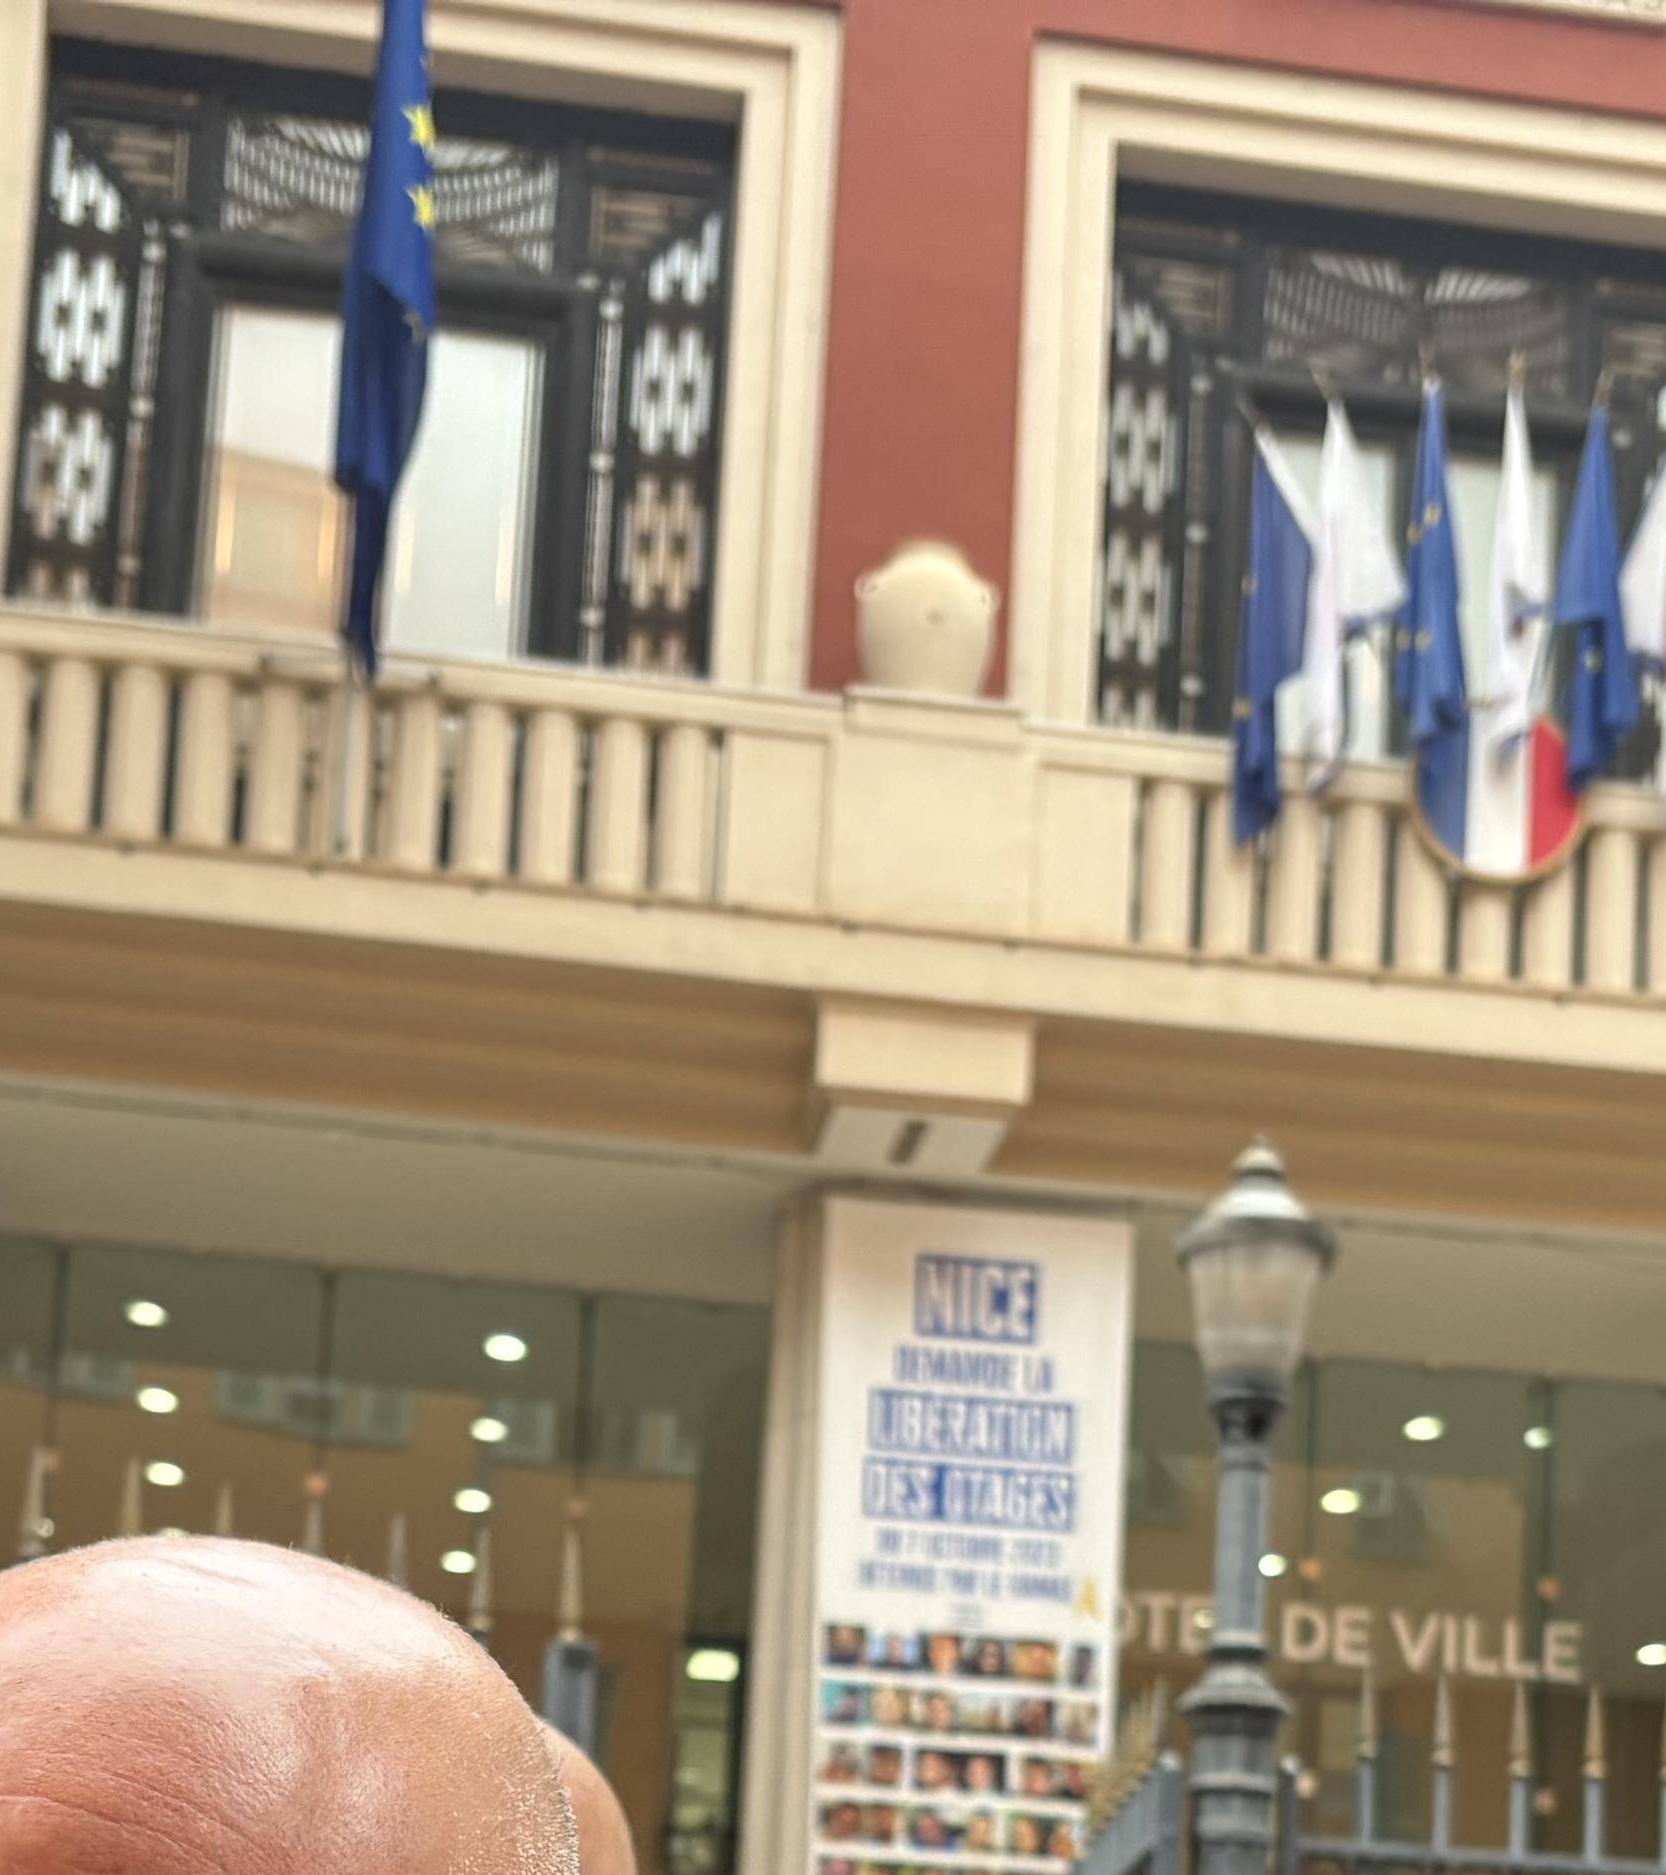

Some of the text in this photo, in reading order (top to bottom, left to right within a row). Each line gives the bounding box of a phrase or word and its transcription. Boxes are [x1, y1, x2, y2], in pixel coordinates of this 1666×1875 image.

[918, 1259, 1035, 1340] NICE
[942, 1464, 1072, 1528] OTAGES
[1283, 1603, 1371, 1666] DE
[1391, 1609, 1582, 1682] VILLE
